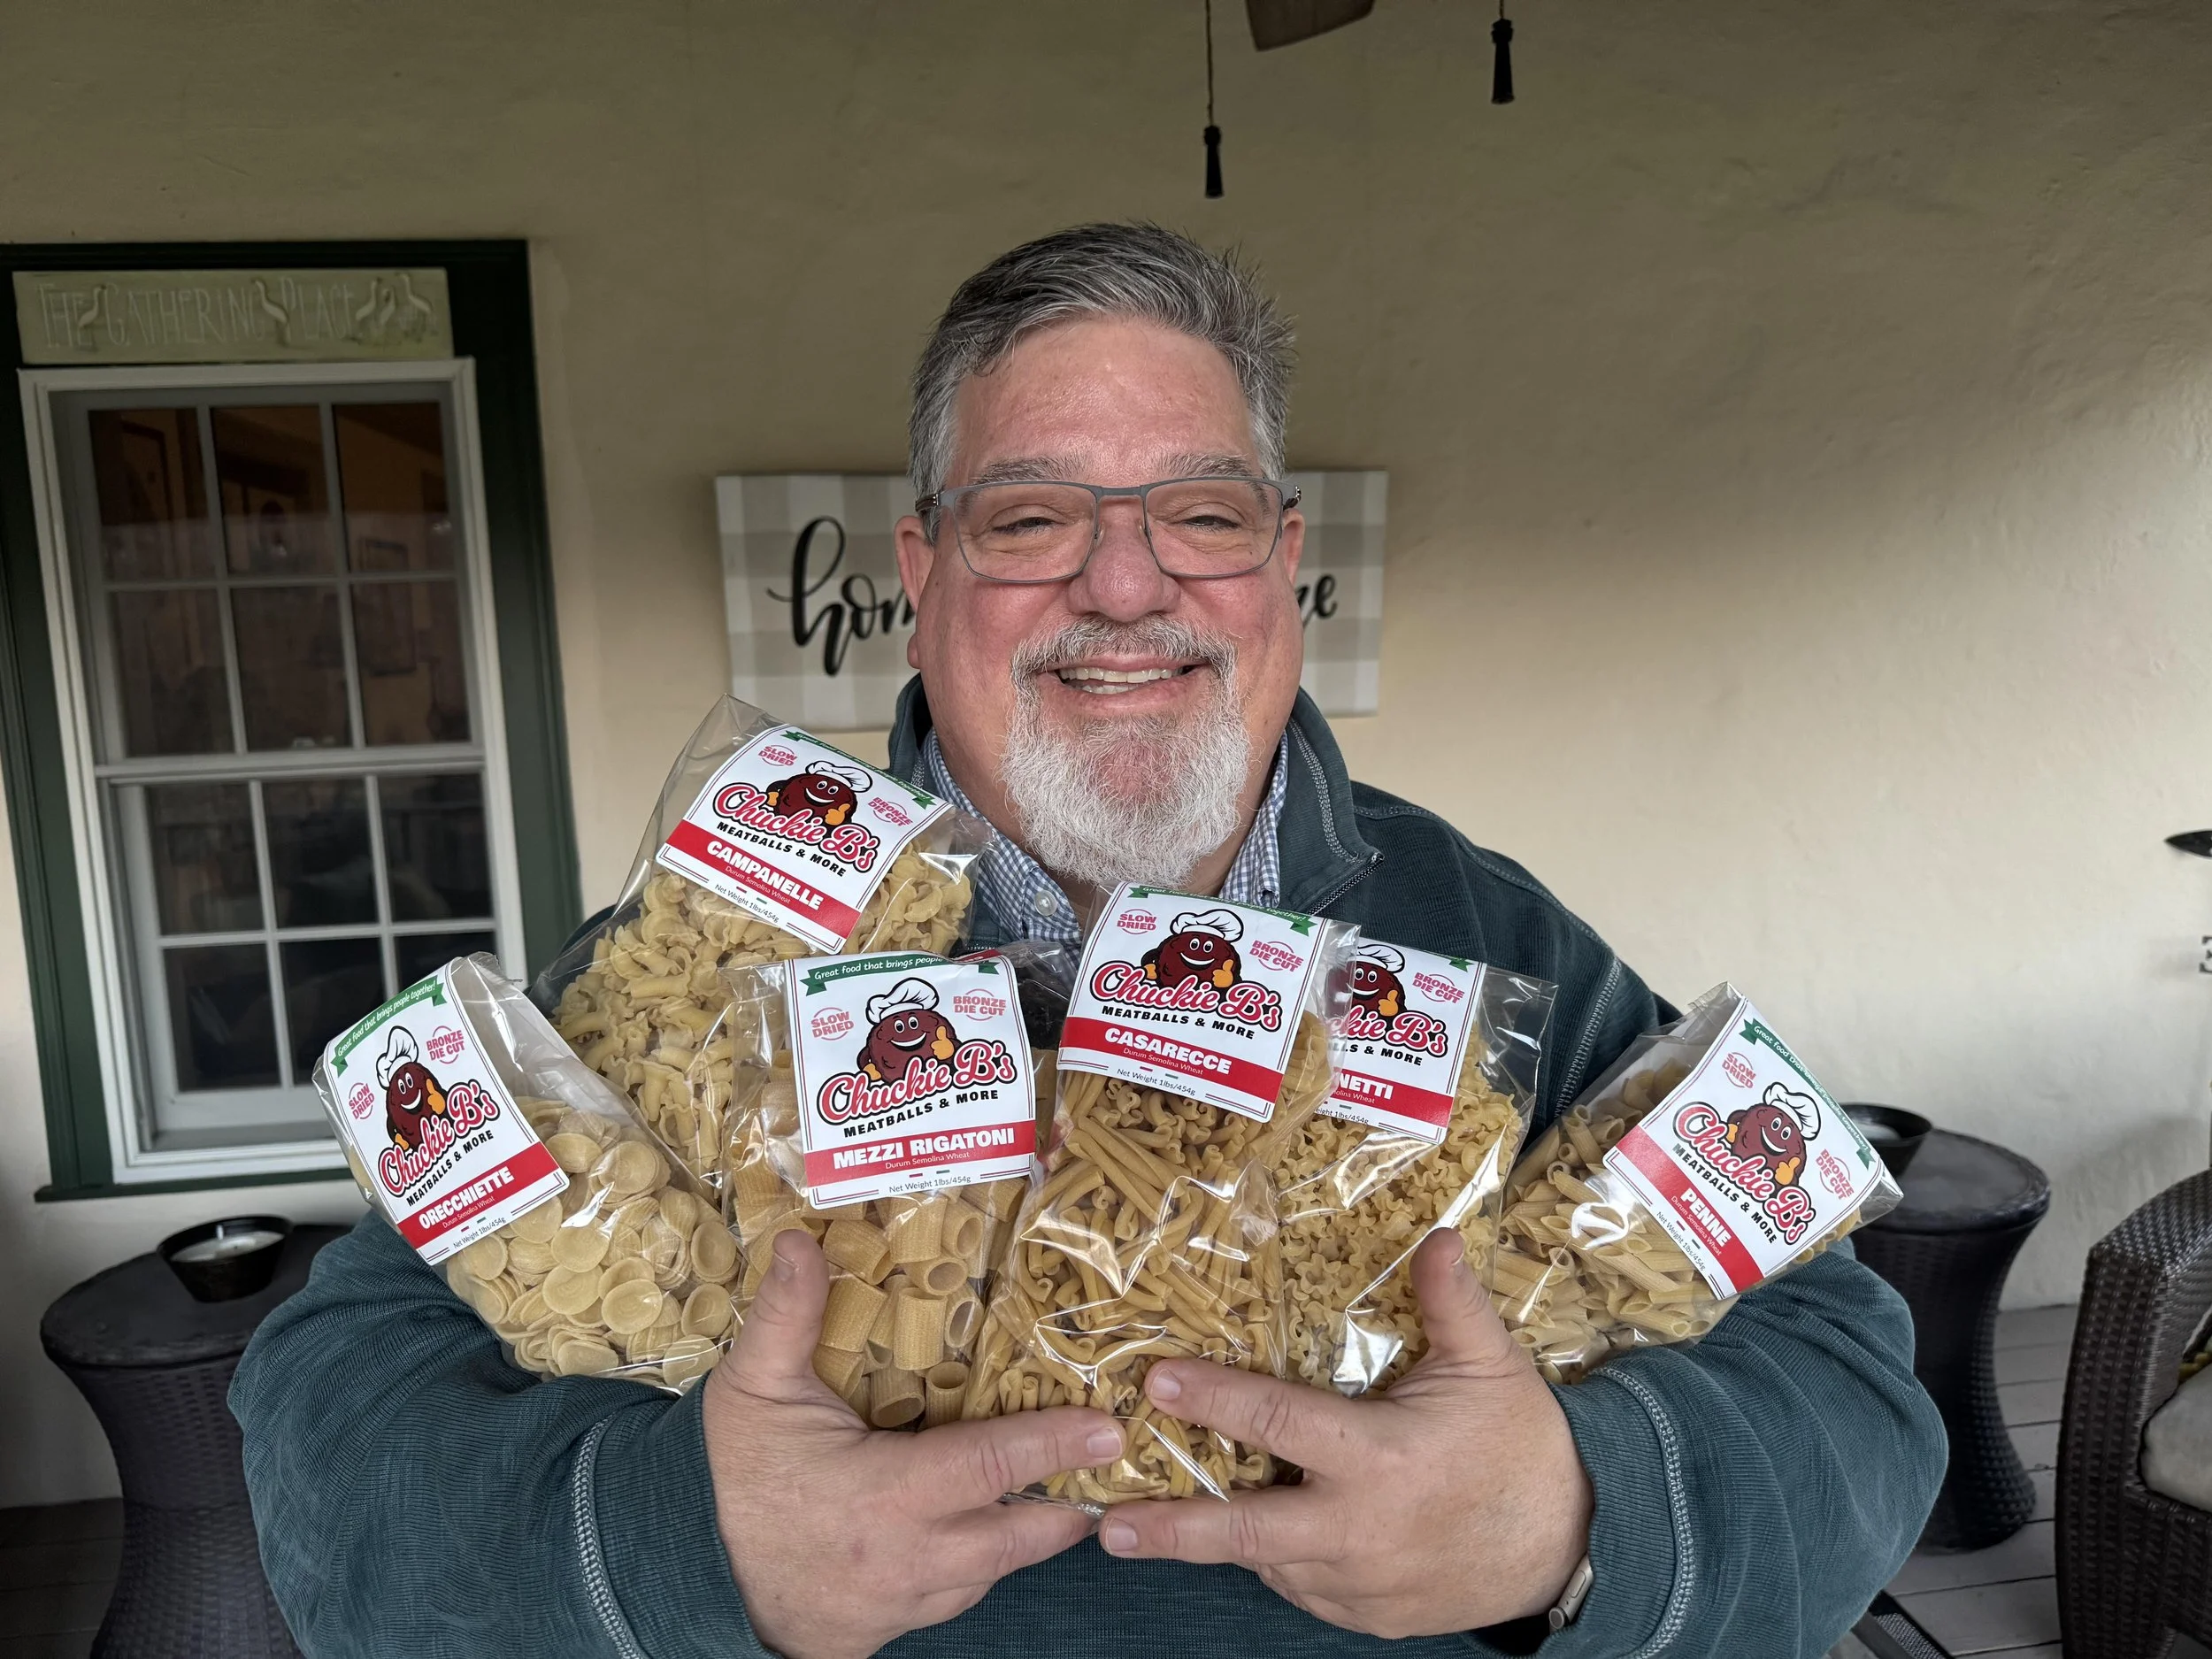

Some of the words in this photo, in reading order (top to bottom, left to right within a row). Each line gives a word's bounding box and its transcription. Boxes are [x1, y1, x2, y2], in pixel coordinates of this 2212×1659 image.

[757, 750, 795, 766] DRIED
[764, 746, 798, 761] SLOW
[868, 801, 887, 815] DIE
[885, 812, 906, 827] CUT
[872, 797, 913, 825] BRONZE
[714, 783, 826, 844] Chuckie
[822, 824, 880, 872] B's
[717, 822, 793, 853] MEATBALLS
[795, 849, 805, 858] &
[810, 854, 846, 878] MORE
[707, 841, 825, 910] CAMPANELLE
[726, 865, 745, 879] Durum
[745, 876, 771, 894] Semolina
[772, 890, 791, 904] Wheat
[715, 884, 726, 895] Net
[727, 889, 749, 906] Weight
[749, 902, 780, 924] 1lbs/454g
[1119, 913, 1157, 923] SLOW
[1117, 920, 1156, 931] DRIED
[1249, 948, 1271, 962] DIE
[1272, 956, 1299, 972] CUT
[1252, 940, 1304, 966] BRONZE
[814, 969, 840, 980] Great
[842, 963, 862, 974] food
[864, 961, 884, 971] that
[886, 959, 914, 973] brings
[1090, 959, 1220, 1013] Chuckie
[1217, 980, 1282, 1032] B's
[1412, 979, 1434, 993] DIE
[1435, 989, 1461, 1004] CUT
[1415, 972, 1465, 998] BRONZE
[953, 995, 1007, 1008] BRONZE
[954, 1005, 977, 1014] DIE
[979, 1006, 1005, 1016] CUT
[338, 1040, 352, 1056] Great
[352, 1027, 365, 1042] food
[365, 1017, 376, 1031] that
[376, 1004, 393, 1021] brings
[393, 993, 411, 1012] people
[411, 979, 436, 1001] together!
[810, 1011, 849, 1028] SLOW
[812, 1020, 854, 1038] DRIED
[1102, 1005, 1190, 1025] MEATBALLS
[1194, 1018, 1206, 1027] &
[1211, 1020, 1256, 1040] MORE
[426, 1030, 465, 1051] BRONZE
[1386, 1010, 1448, 1058] B's
[430, 1049, 446, 1061] DIE
[446, 1041, 465, 1055] CUT
[1105, 1027, 1233, 1075] CASARECCE
[1123, 1048, 1148, 1059] Durum
[1148, 1053, 1179, 1069] Semolina
[1180, 1064, 1204, 1076] Wheat
[1363, 1046, 1375, 1055] &
[1380, 1048, 1423, 1066] MORE
[1754, 1025, 1773, 1045] Great
[1773, 1041, 1790, 1057] food
[1789, 1056, 1805, 1072] that
[1722, 1060, 1754, 1088] DRIED
[1726, 1053, 1756, 1080] SLOW
[817, 1055, 952, 1125] Chuckie
[953, 1039, 1017, 1089] B's
[1117, 1068, 1131, 1077] Net
[1132, 1071, 1158, 1085] Weight
[1158, 1079, 1196, 1096] 1lbs/454g
[349, 1083, 370, 1110] SLOW
[352, 1093, 375, 1119] DRIED
[1353, 1093, 1375, 1103] Wheat
[844, 1103, 933, 1138] MEATBALLS
[939, 1098, 949, 1108] &
[956, 1090, 998, 1104] MORE
[380, 1116, 456, 1195] Chuckie
[448, 1079, 499, 1138] B's
[833, 1141, 904, 1169] MEZZI
[910, 1127, 1015, 1156] RIGATONI
[406, 1158, 453, 1207] MEATBALLS
[455, 1151, 462, 1161] &
[463, 1130, 494, 1154] MORE
[885, 1159, 911, 1170] Durum
[912, 1155, 945, 1164] Semolina
[1673, 1102, 1775, 1202] Chuckie
[1763, 1186, 1816, 1245] B's
[1820, 1148, 1855, 1197] BRONZE
[889, 1185, 903, 1194] Net
[904, 1180, 933, 1191] Weight
[934, 1175, 972, 1187] 1lbs/454g
[1816, 1156, 1832, 1178] DIE
[1830, 1177, 1847, 1200] CUT
[419, 1166, 515, 1230] ORECCHIETTE
[1671, 1143, 1740, 1202] MEATBALLS
[1740, 1202, 1750, 1213] &
[1750, 1212, 1778, 1244] MORE
[442, 1217, 458, 1228] Durum
[457, 1206, 479, 1221] Semolina
[478, 1195, 495, 1209] Wheat
[1671, 1195, 1688, 1216] Durum
[1686, 1214, 1708, 1240] Semolina
[1706, 1237, 1722, 1256] Wheat
[1680, 1187, 1732, 1248] PENNE
[463, 1232, 480, 1244] Weight
[480, 1217, 506, 1235] 1lbs/454g
[1656, 1211, 1667, 1225] Net
[1667, 1221, 1684, 1244] Weight
[1683, 1242, 1706, 1271] 1lbs/454g
